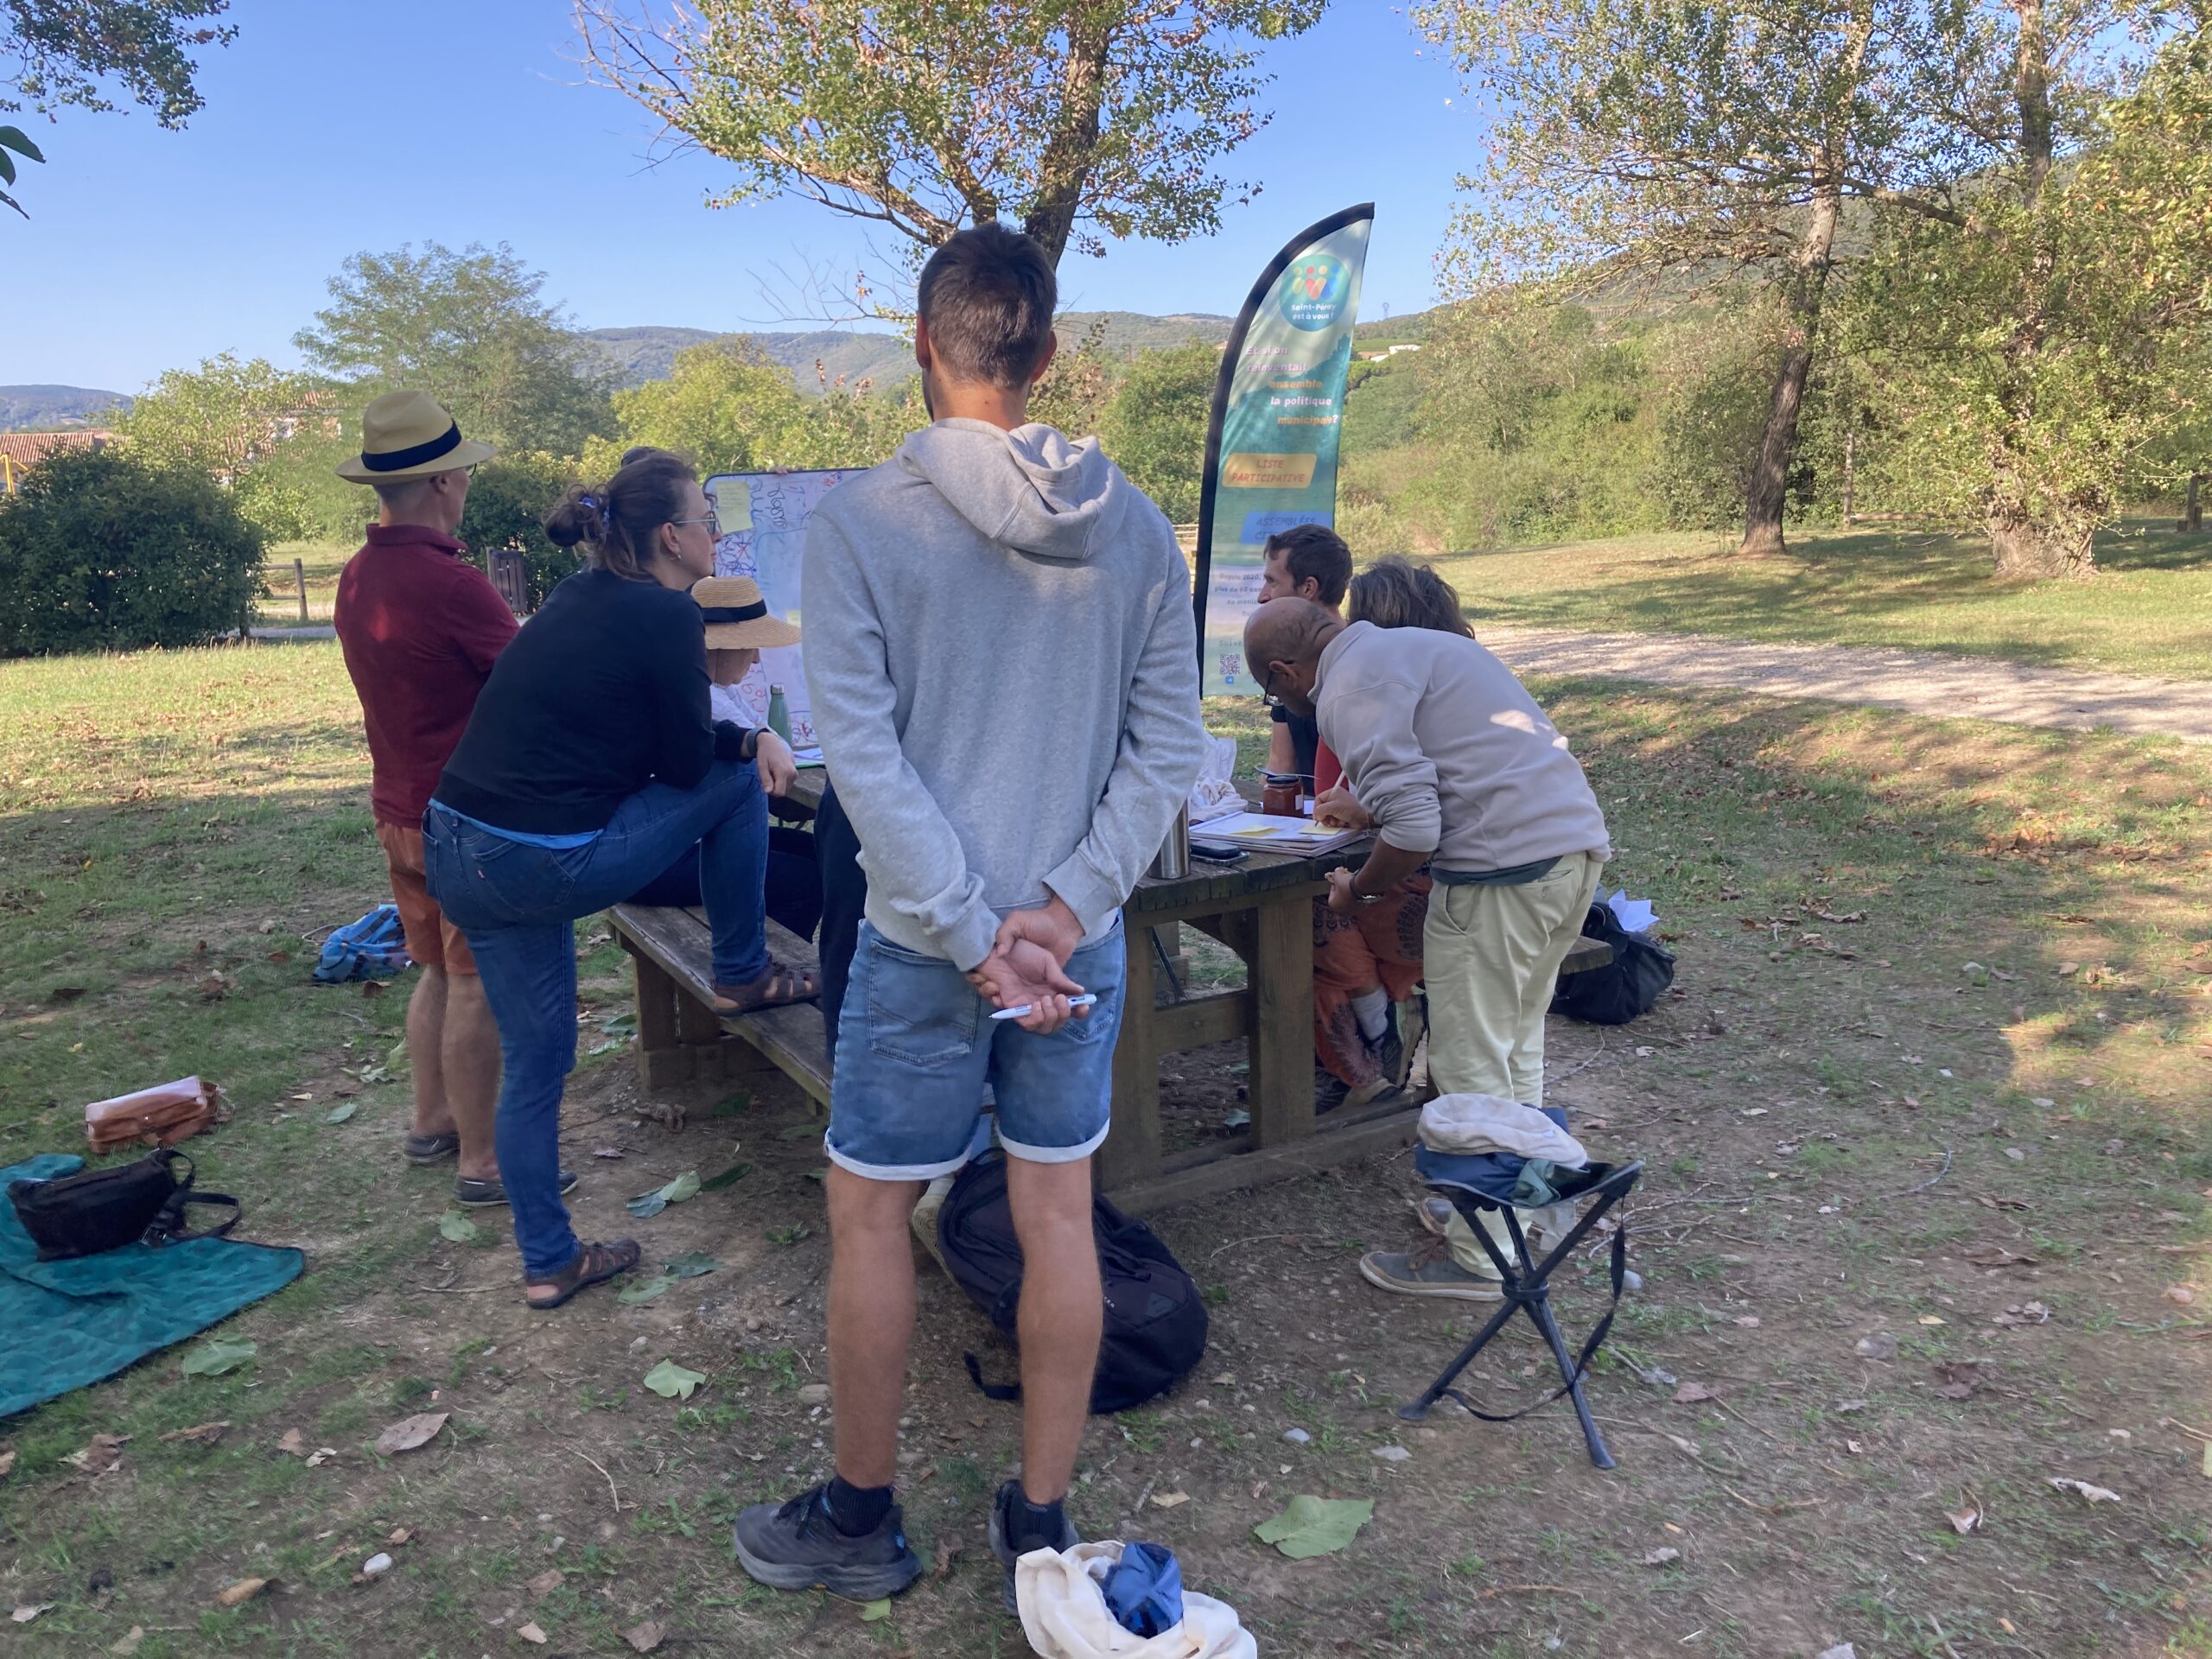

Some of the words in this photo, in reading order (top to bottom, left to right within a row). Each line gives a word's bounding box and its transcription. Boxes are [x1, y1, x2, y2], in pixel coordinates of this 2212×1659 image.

[1245, 346, 1259, 356] Et
[1262, 346, 1272, 355] si
[1274, 346, 1289, 356] on
[1271, 379, 1323, 388] ensemble
[1271, 396, 1281, 405] la
[1284, 396, 1332, 408] politique
[1256, 460, 1285, 468] LISTE
[1231, 473, 1305, 483] PARTICIPATIVE
[1255, 514, 1317, 526] ASSEMBLÉES
